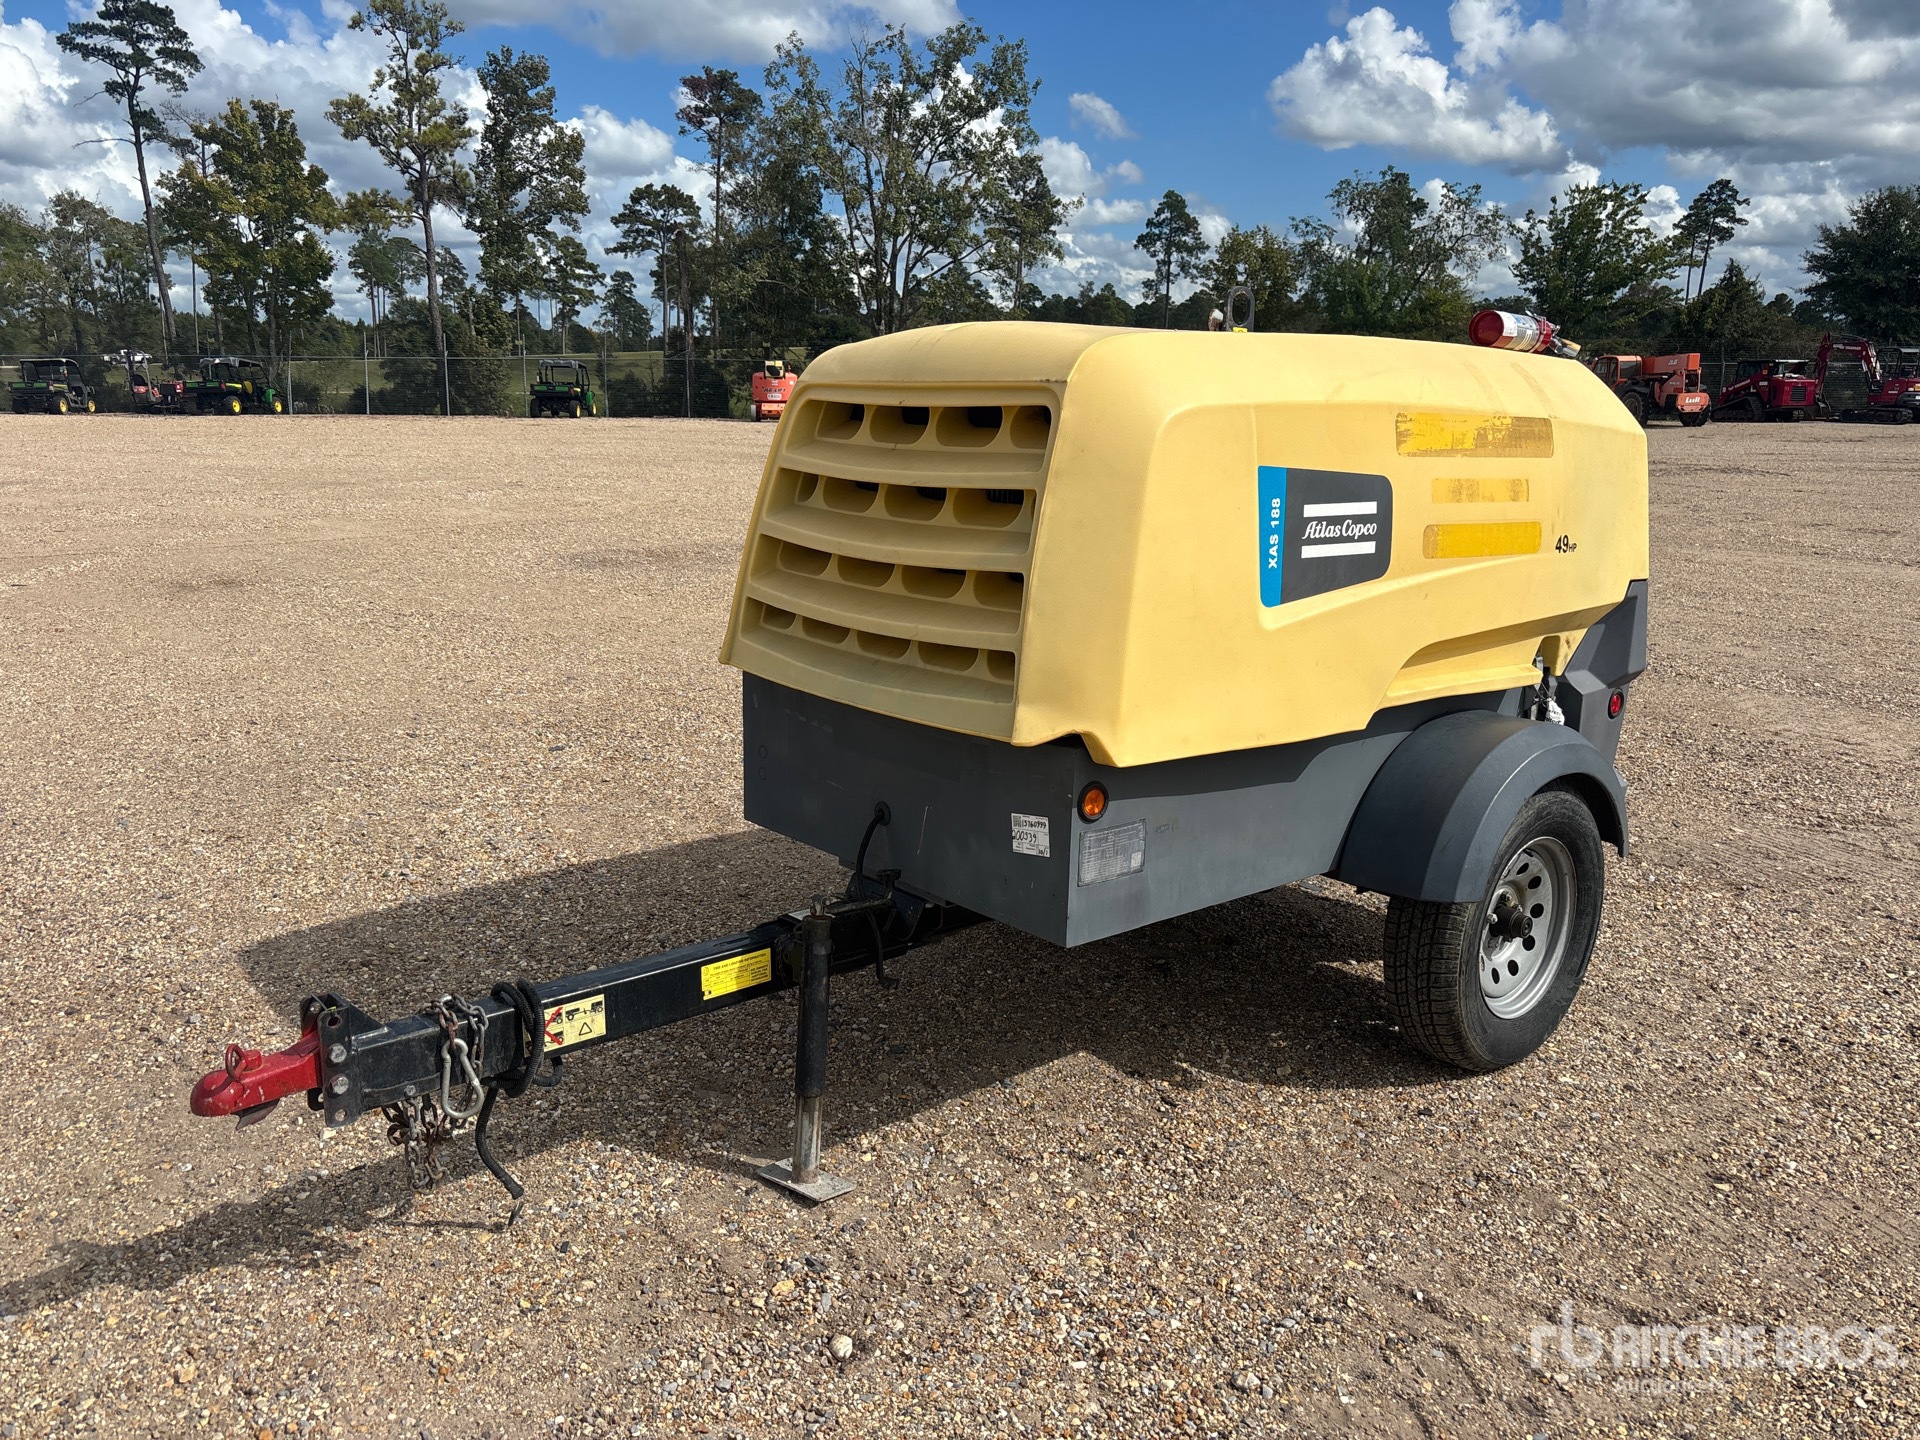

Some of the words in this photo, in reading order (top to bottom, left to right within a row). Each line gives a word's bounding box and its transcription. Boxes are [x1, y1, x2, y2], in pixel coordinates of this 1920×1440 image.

[1270, 497, 1281, 528] 188
[1302, 521, 1341, 540] Atlas
[1342, 519, 1377, 540] Copco
[1268, 533, 1279, 569] XAS
